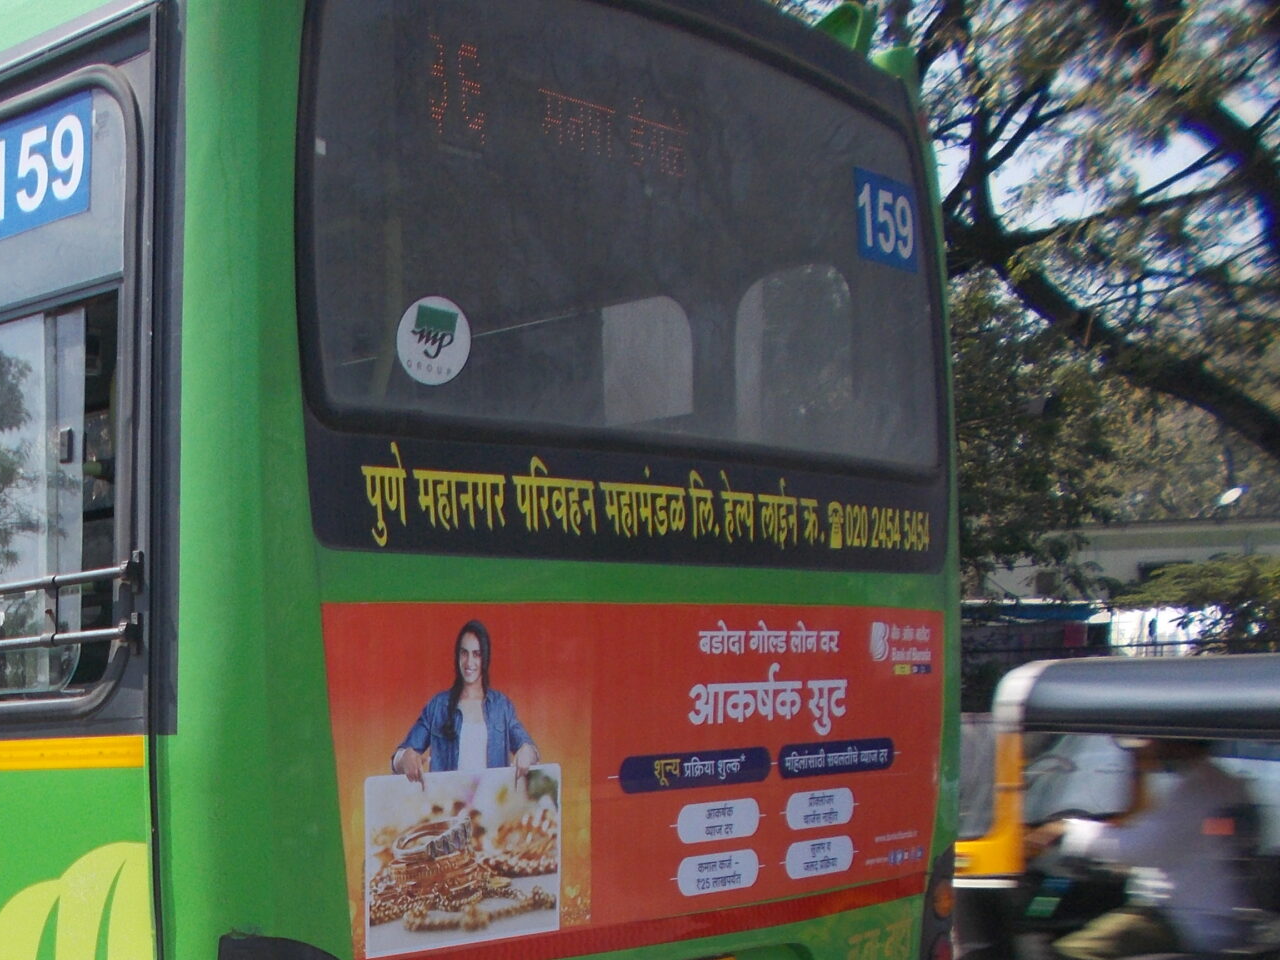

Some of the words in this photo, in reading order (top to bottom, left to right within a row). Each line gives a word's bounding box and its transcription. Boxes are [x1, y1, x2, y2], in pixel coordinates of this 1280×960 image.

[858, 182, 914, 260] 159
[360, 441, 407, 547] पुणे
[412, 468, 506, 531] महानगर
[512, 455, 596, 536] परिवहन
[599, 464, 687, 538] महामंडळ
[688, 469, 720, 541] लि.
[720, 469, 755, 544] हेल्प
[845, 503, 869, 548] 020
[870, 505, 901, 550] 2454
[699, 619, 746, 655] बडोदा
[750, 619, 788, 655] गोल्ड
[790, 620, 818, 653] लोन
[820, 630, 841, 653] वर
[688, 662, 803, 726] आकर्षक
[807, 679, 849, 736] सुट
[653, 758, 681, 787] शून्य
